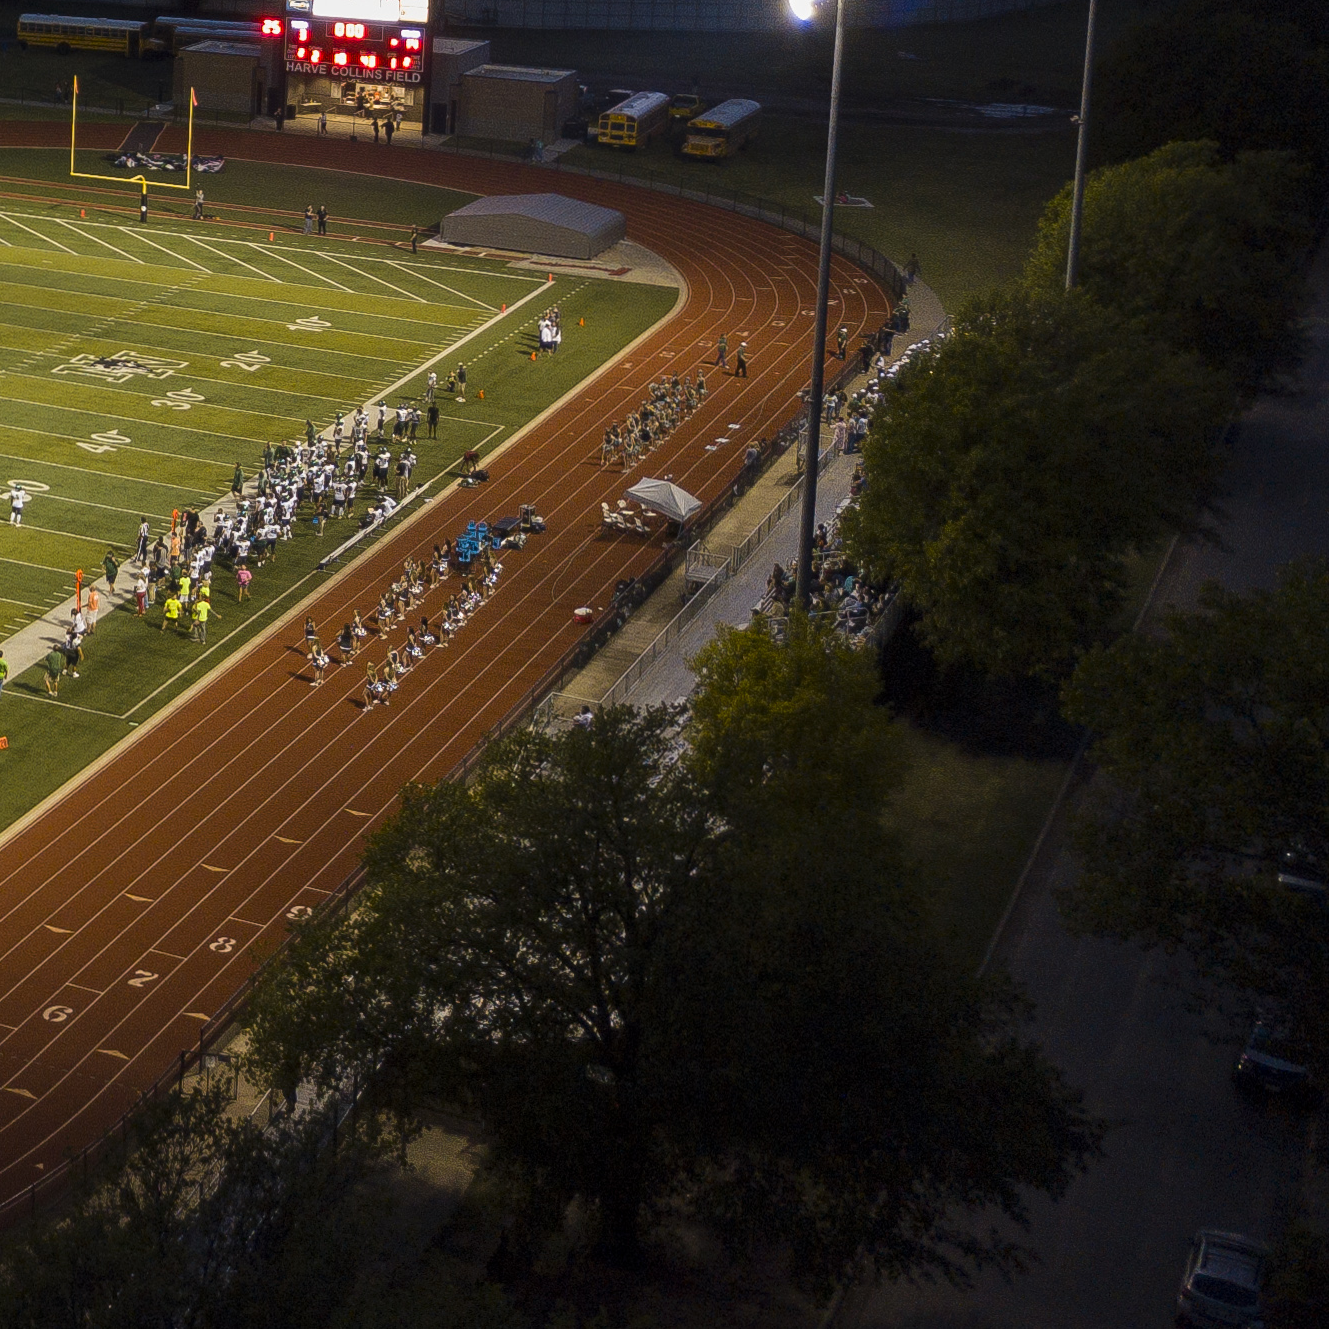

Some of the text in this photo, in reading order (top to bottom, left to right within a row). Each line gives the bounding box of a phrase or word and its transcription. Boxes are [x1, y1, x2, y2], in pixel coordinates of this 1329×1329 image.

[286, 62, 327, 75] HARVE
[331, 66, 383, 80] COLLINS
[385, 71, 421, 83] FIELD
[287, 316, 332, 332] 10
[221, 350, 272, 372] 20
[151, 387, 206, 411] 30
[76, 429, 132, 453] 40
[42, 1005, 75, 1023] 6
[126, 969, 160, 989] 7
[208, 936, 238, 954] 8
